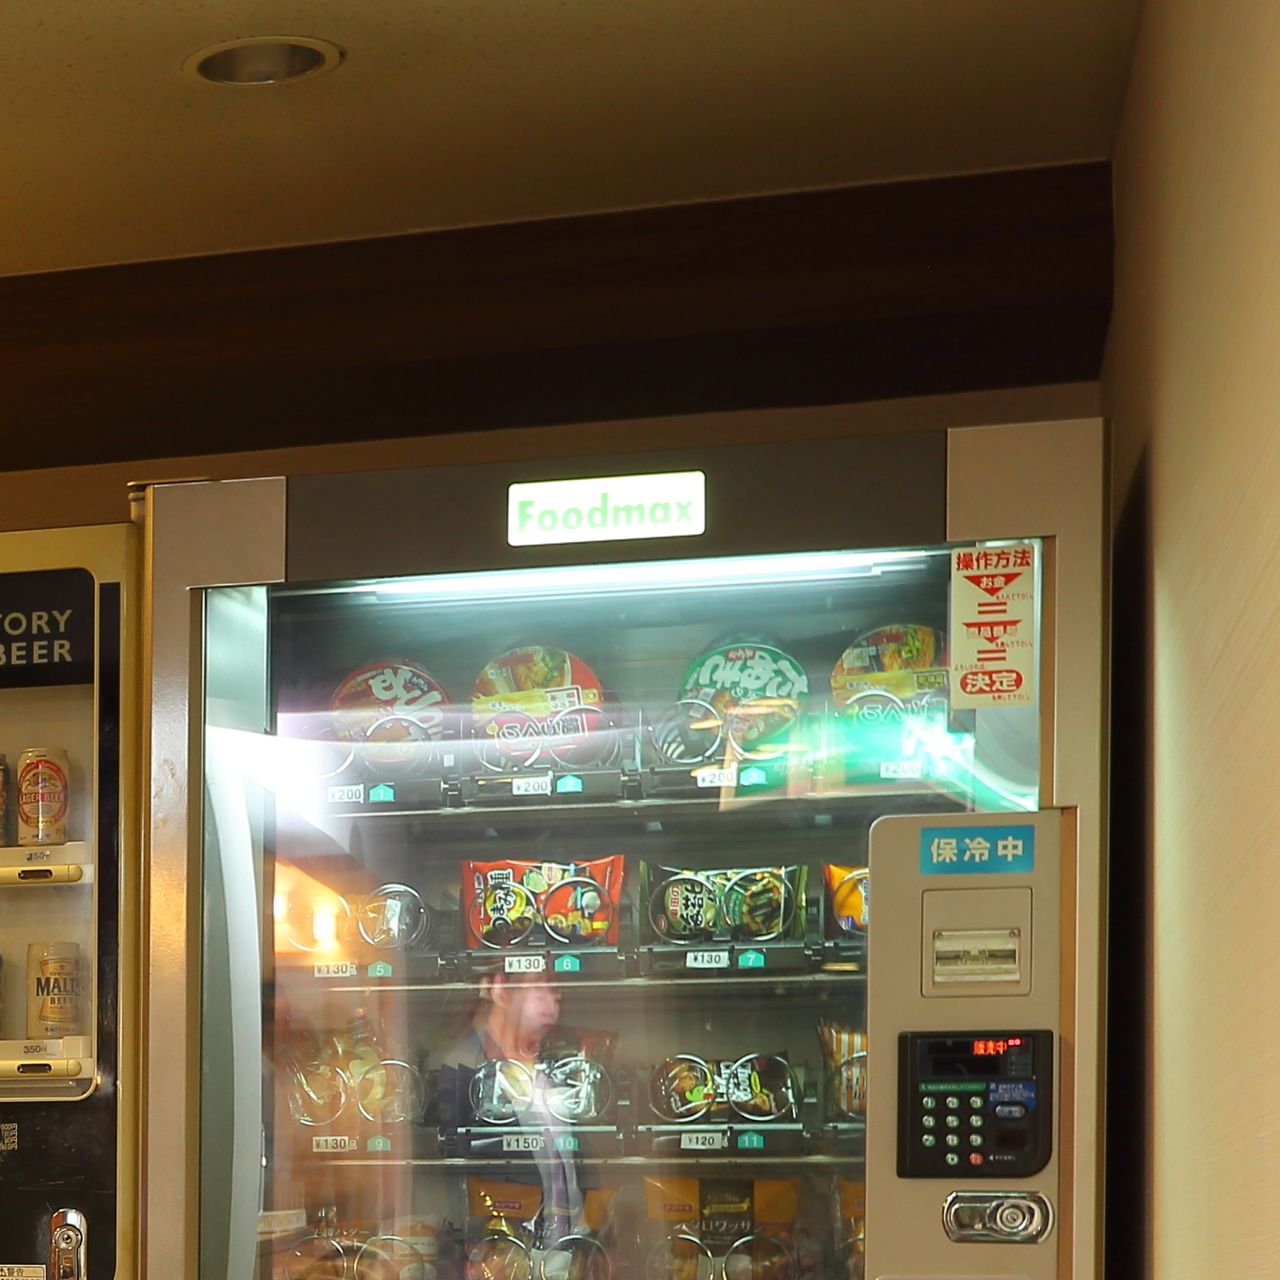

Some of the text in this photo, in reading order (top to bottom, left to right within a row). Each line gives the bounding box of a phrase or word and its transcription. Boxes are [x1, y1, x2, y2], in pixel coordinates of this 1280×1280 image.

[517, 492, 694, 534] Foodmax
[956, 550, 1031, 571] 操作方法
[980, 576, 1006, 589] お金
[965, 672, 1017, 693] 決定
[700, 771, 734, 784] ¥200
[516, 780, 549, 793] ¥200
[930, 836, 1023, 863] 保冷中
[507, 957, 540, 971] ¥130
[562, 956, 572, 969] 6
[693, 951, 722, 965] ¥130
[746, 954, 756, 966] 7
[317, 963, 348, 975] ¥130
[375, 964, 384, 976] 5
[314, 1138, 347, 1149] ¥130
[505, 1137, 539, 1150] ¥150
[559, 1137, 575, 1149] 10
[687, 1134, 716, 1146] ¥120
[743, 1134, 757, 1147] 11
